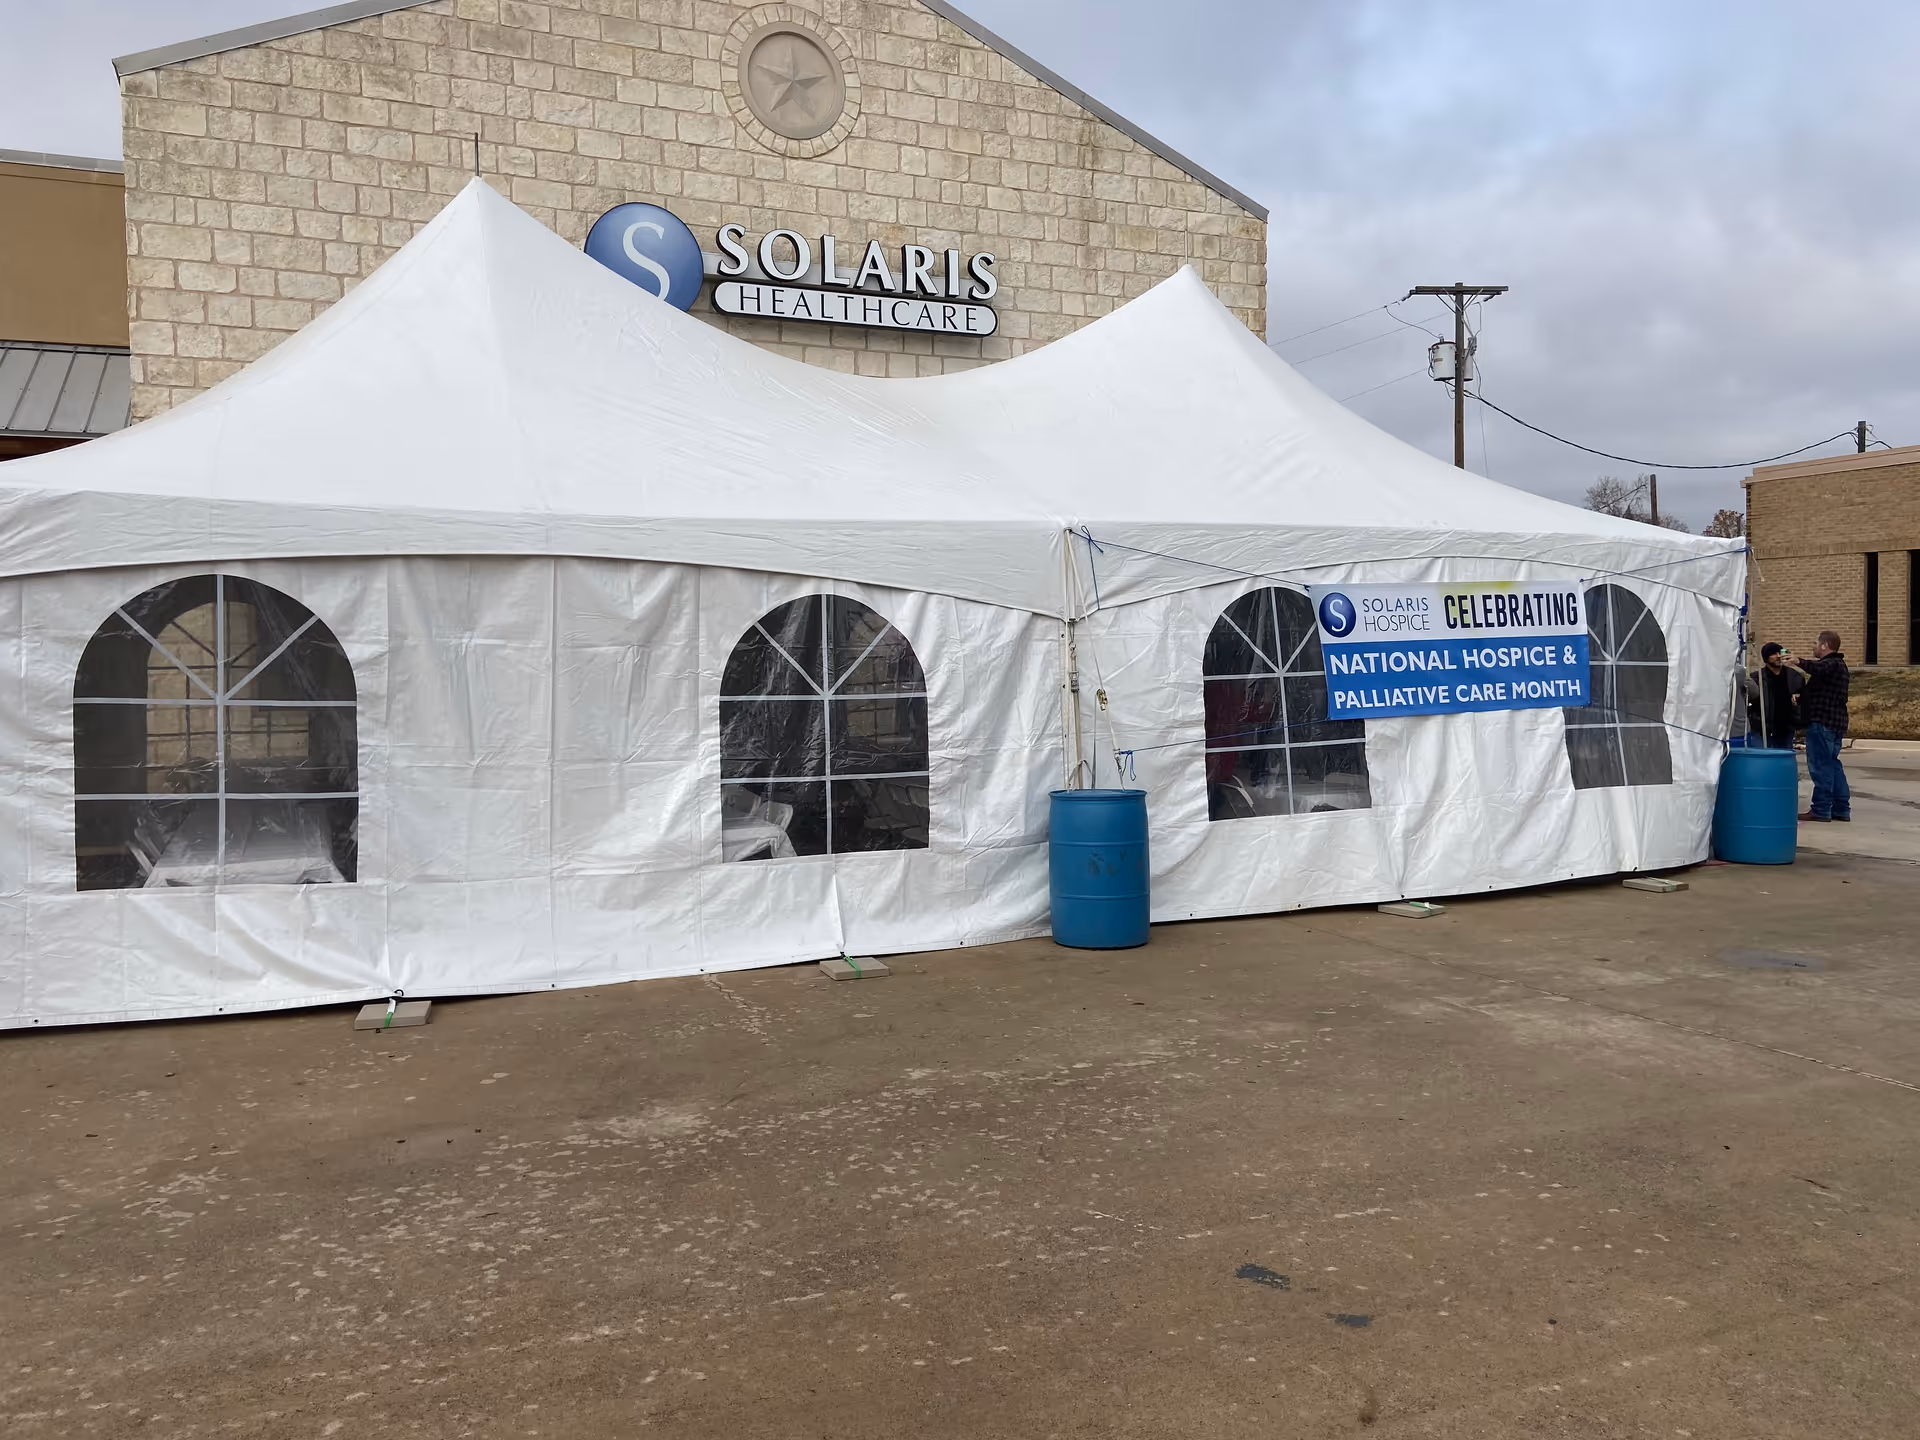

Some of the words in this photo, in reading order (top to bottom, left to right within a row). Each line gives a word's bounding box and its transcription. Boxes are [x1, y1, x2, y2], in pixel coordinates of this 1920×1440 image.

[716, 223, 998, 301] SOLARIS
[739, 285, 978, 332] HEALTHCARE
[1329, 599, 1347, 632] S
[1363, 597, 1429, 613] SOLARIS
[1443, 592, 1578, 629] CELEBRATING
[1364, 614, 1430, 632] HOSPICE
[1330, 650, 1457, 675] NATIONAL
[1463, 646, 1557, 669] HOSPICE
[1563, 645, 1577, 665] &
[1334, 685, 1450, 709] PALLIATIVE
[1455, 682, 1507, 702] CARE
[1512, 679, 1581, 699] MONTH
